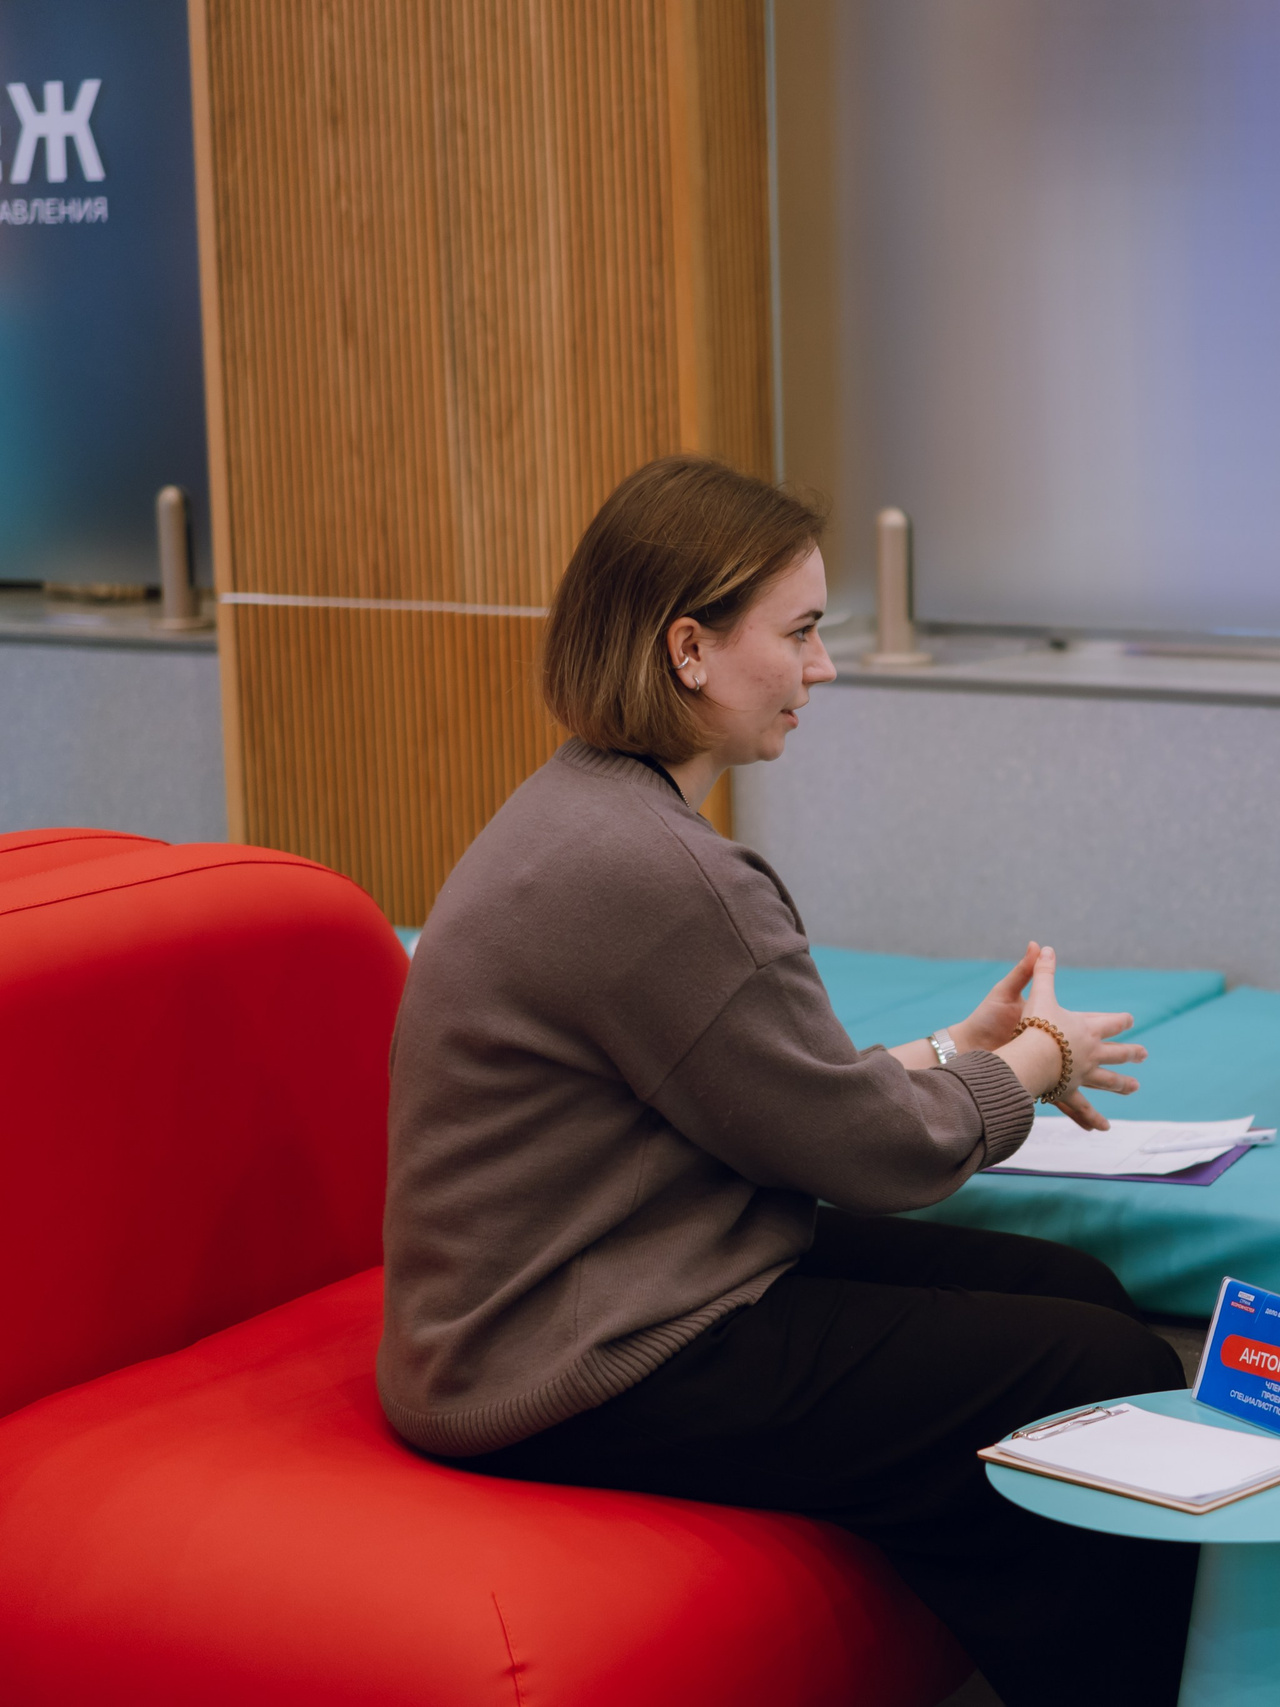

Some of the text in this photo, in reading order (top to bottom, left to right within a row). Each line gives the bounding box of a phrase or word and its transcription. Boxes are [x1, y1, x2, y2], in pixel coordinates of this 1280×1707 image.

[0, 79, 106, 184] Ж
[0, 197, 108, 225] АВЛЕНИЯ
[1230, 1389, 1273, 1412] СПЕЦИАЛИСТ
